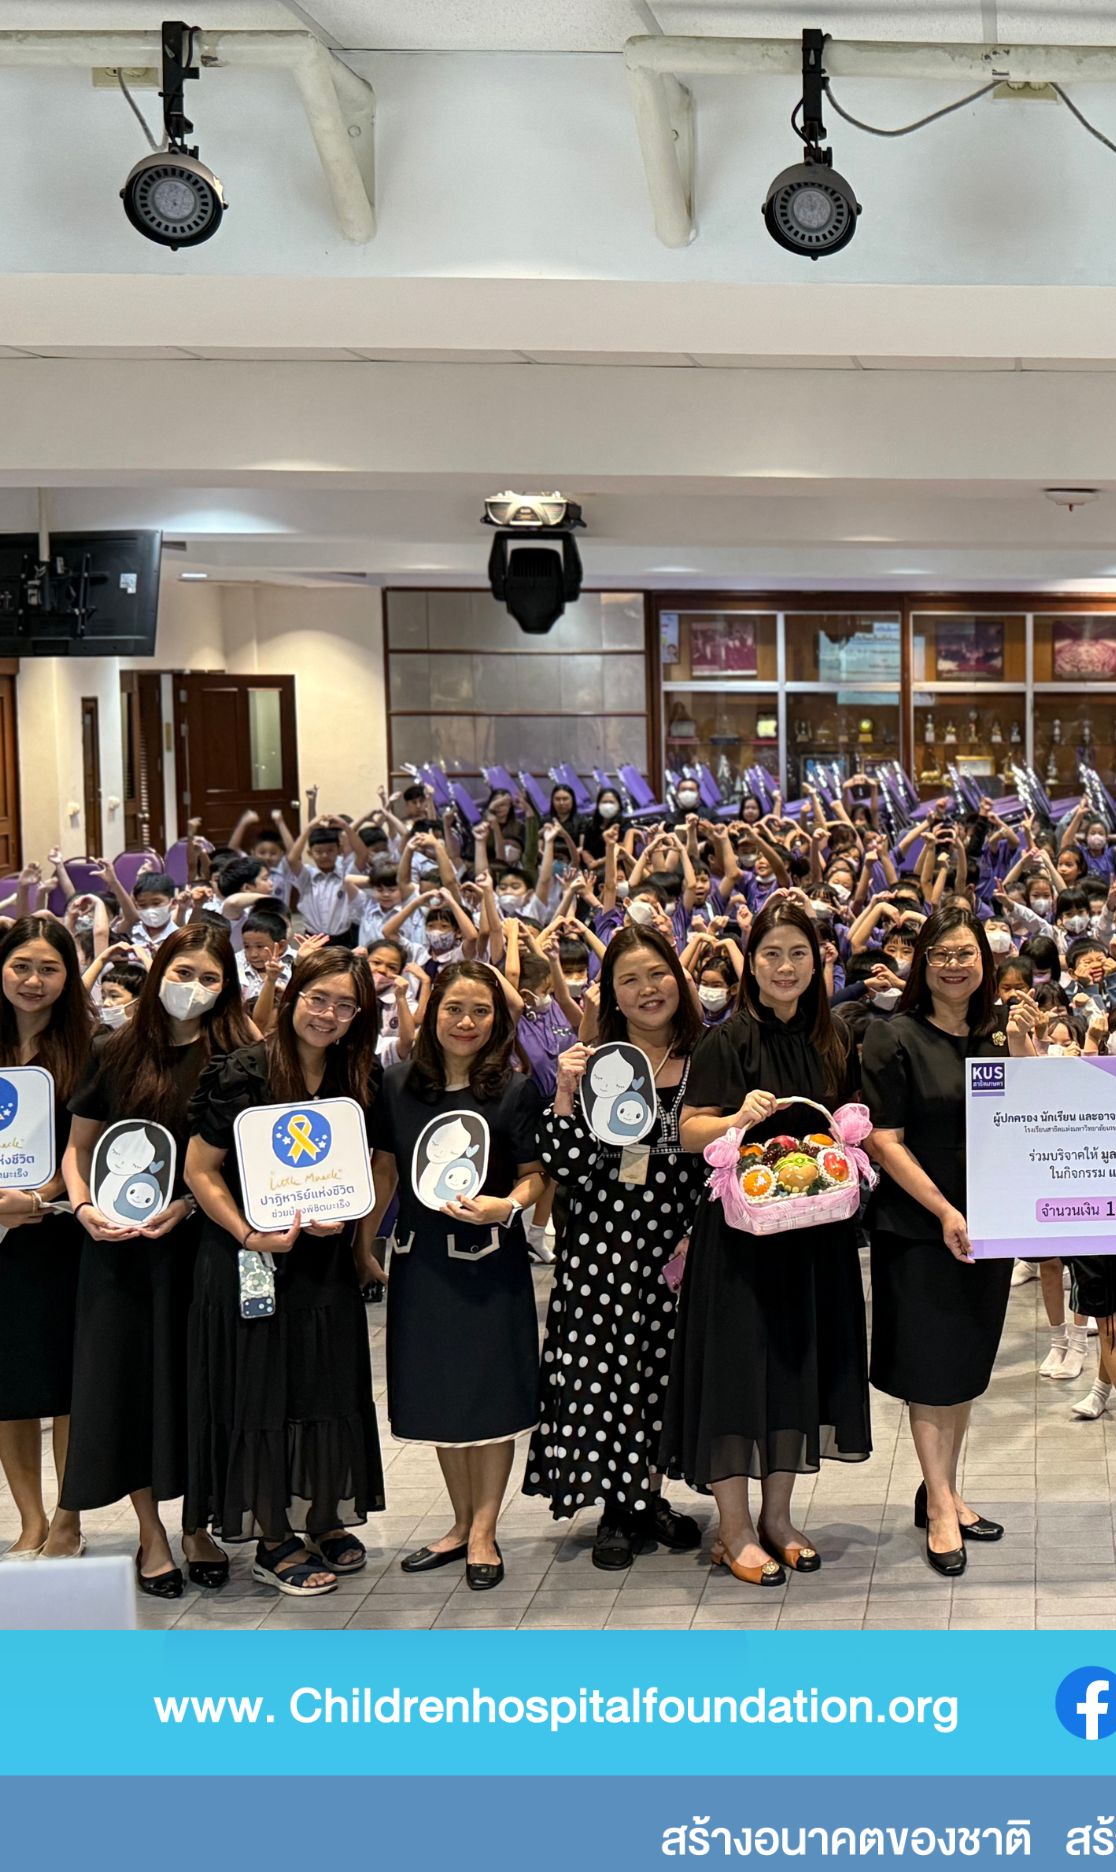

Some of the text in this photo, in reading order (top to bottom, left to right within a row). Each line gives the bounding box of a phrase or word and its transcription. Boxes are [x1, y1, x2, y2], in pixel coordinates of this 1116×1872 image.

[972, 1066, 1004, 1080] KUS
[993, 1110, 1038, 1127] ผู้ปกครอง
[1040, 1109, 1077, 1122] นักเรียน
[1029, 1148, 1099, 1163] ร่วมบริจาคให้
[1050, 1165, 1106, 1180] ในกิจกรรม
[1041, 1200, 1100, 1218] จำนวนเงิน
